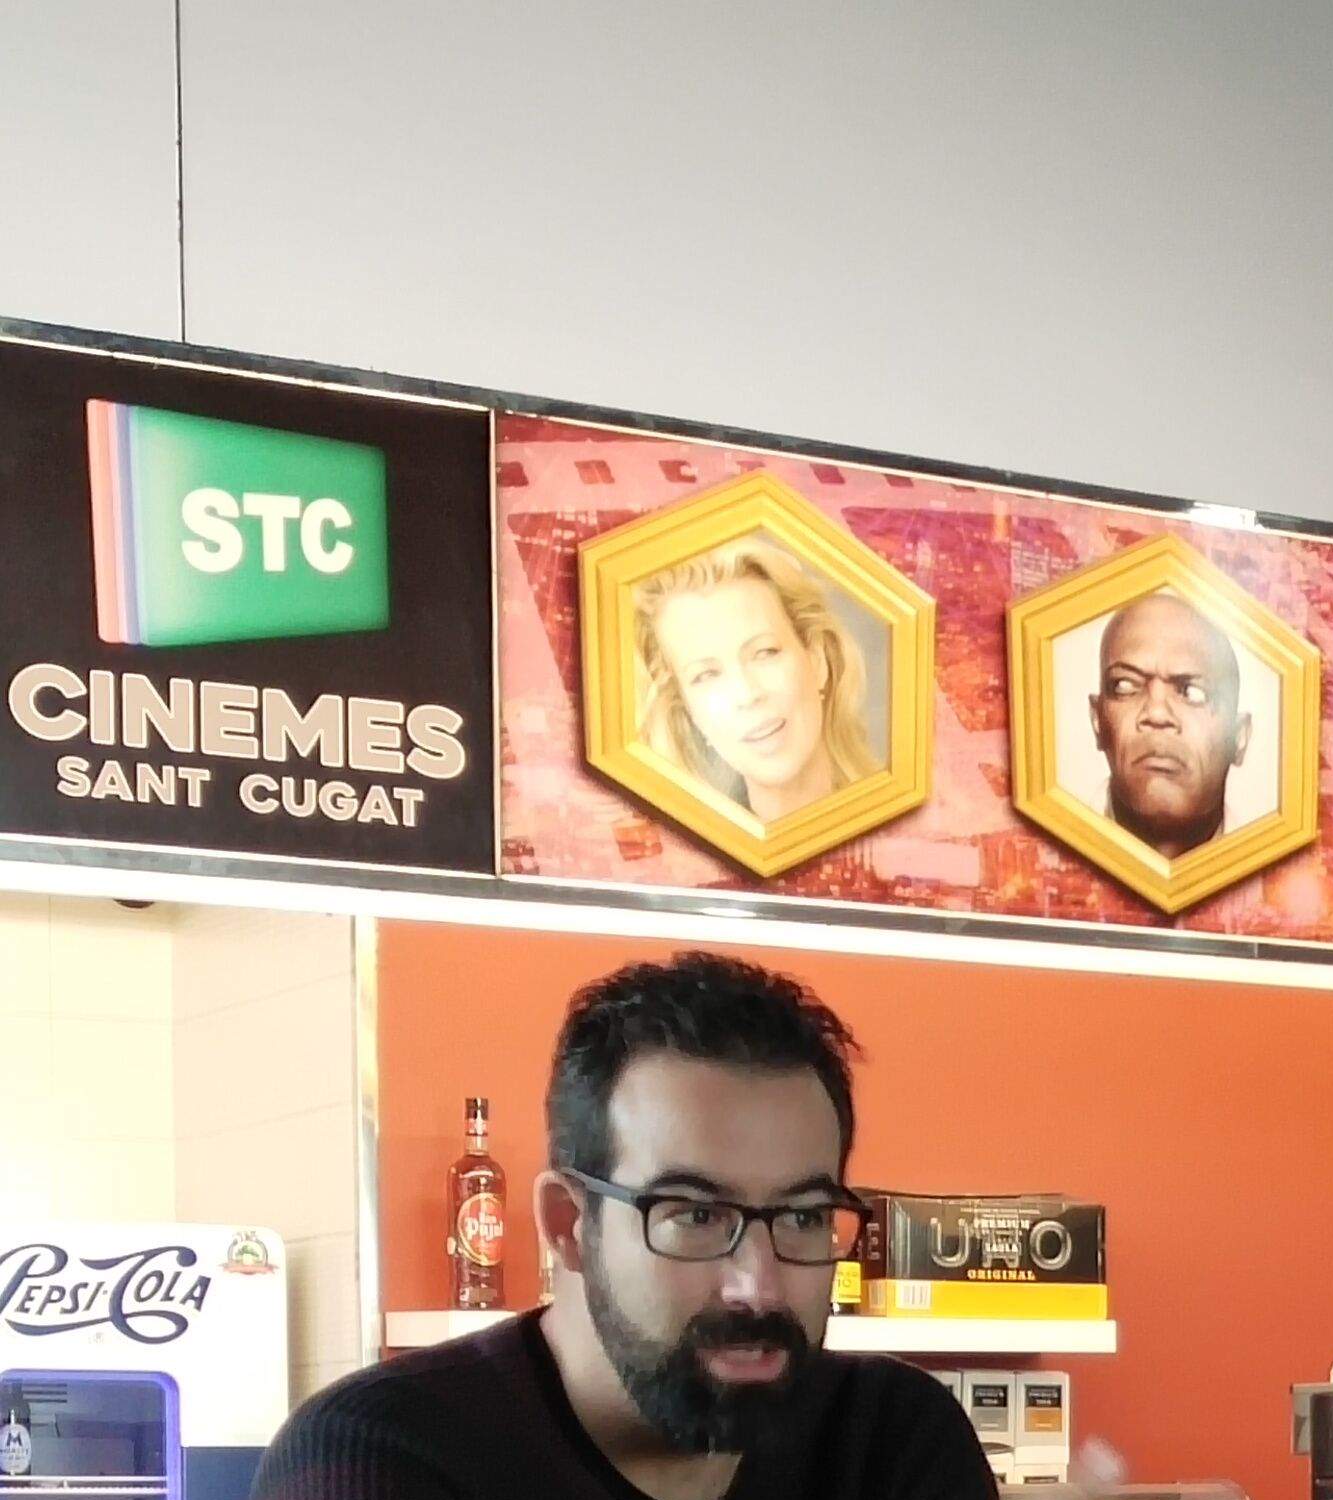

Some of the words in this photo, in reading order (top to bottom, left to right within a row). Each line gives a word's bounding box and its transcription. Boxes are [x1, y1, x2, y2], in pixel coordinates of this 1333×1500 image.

[181, 488, 355, 575] STC
[8, 663, 466, 781] CINEMES
[56, 756, 211, 808] SANT
[239, 773, 424, 828] CUGAT
[966, 1269, 1037, 1281] ORIGINAL
